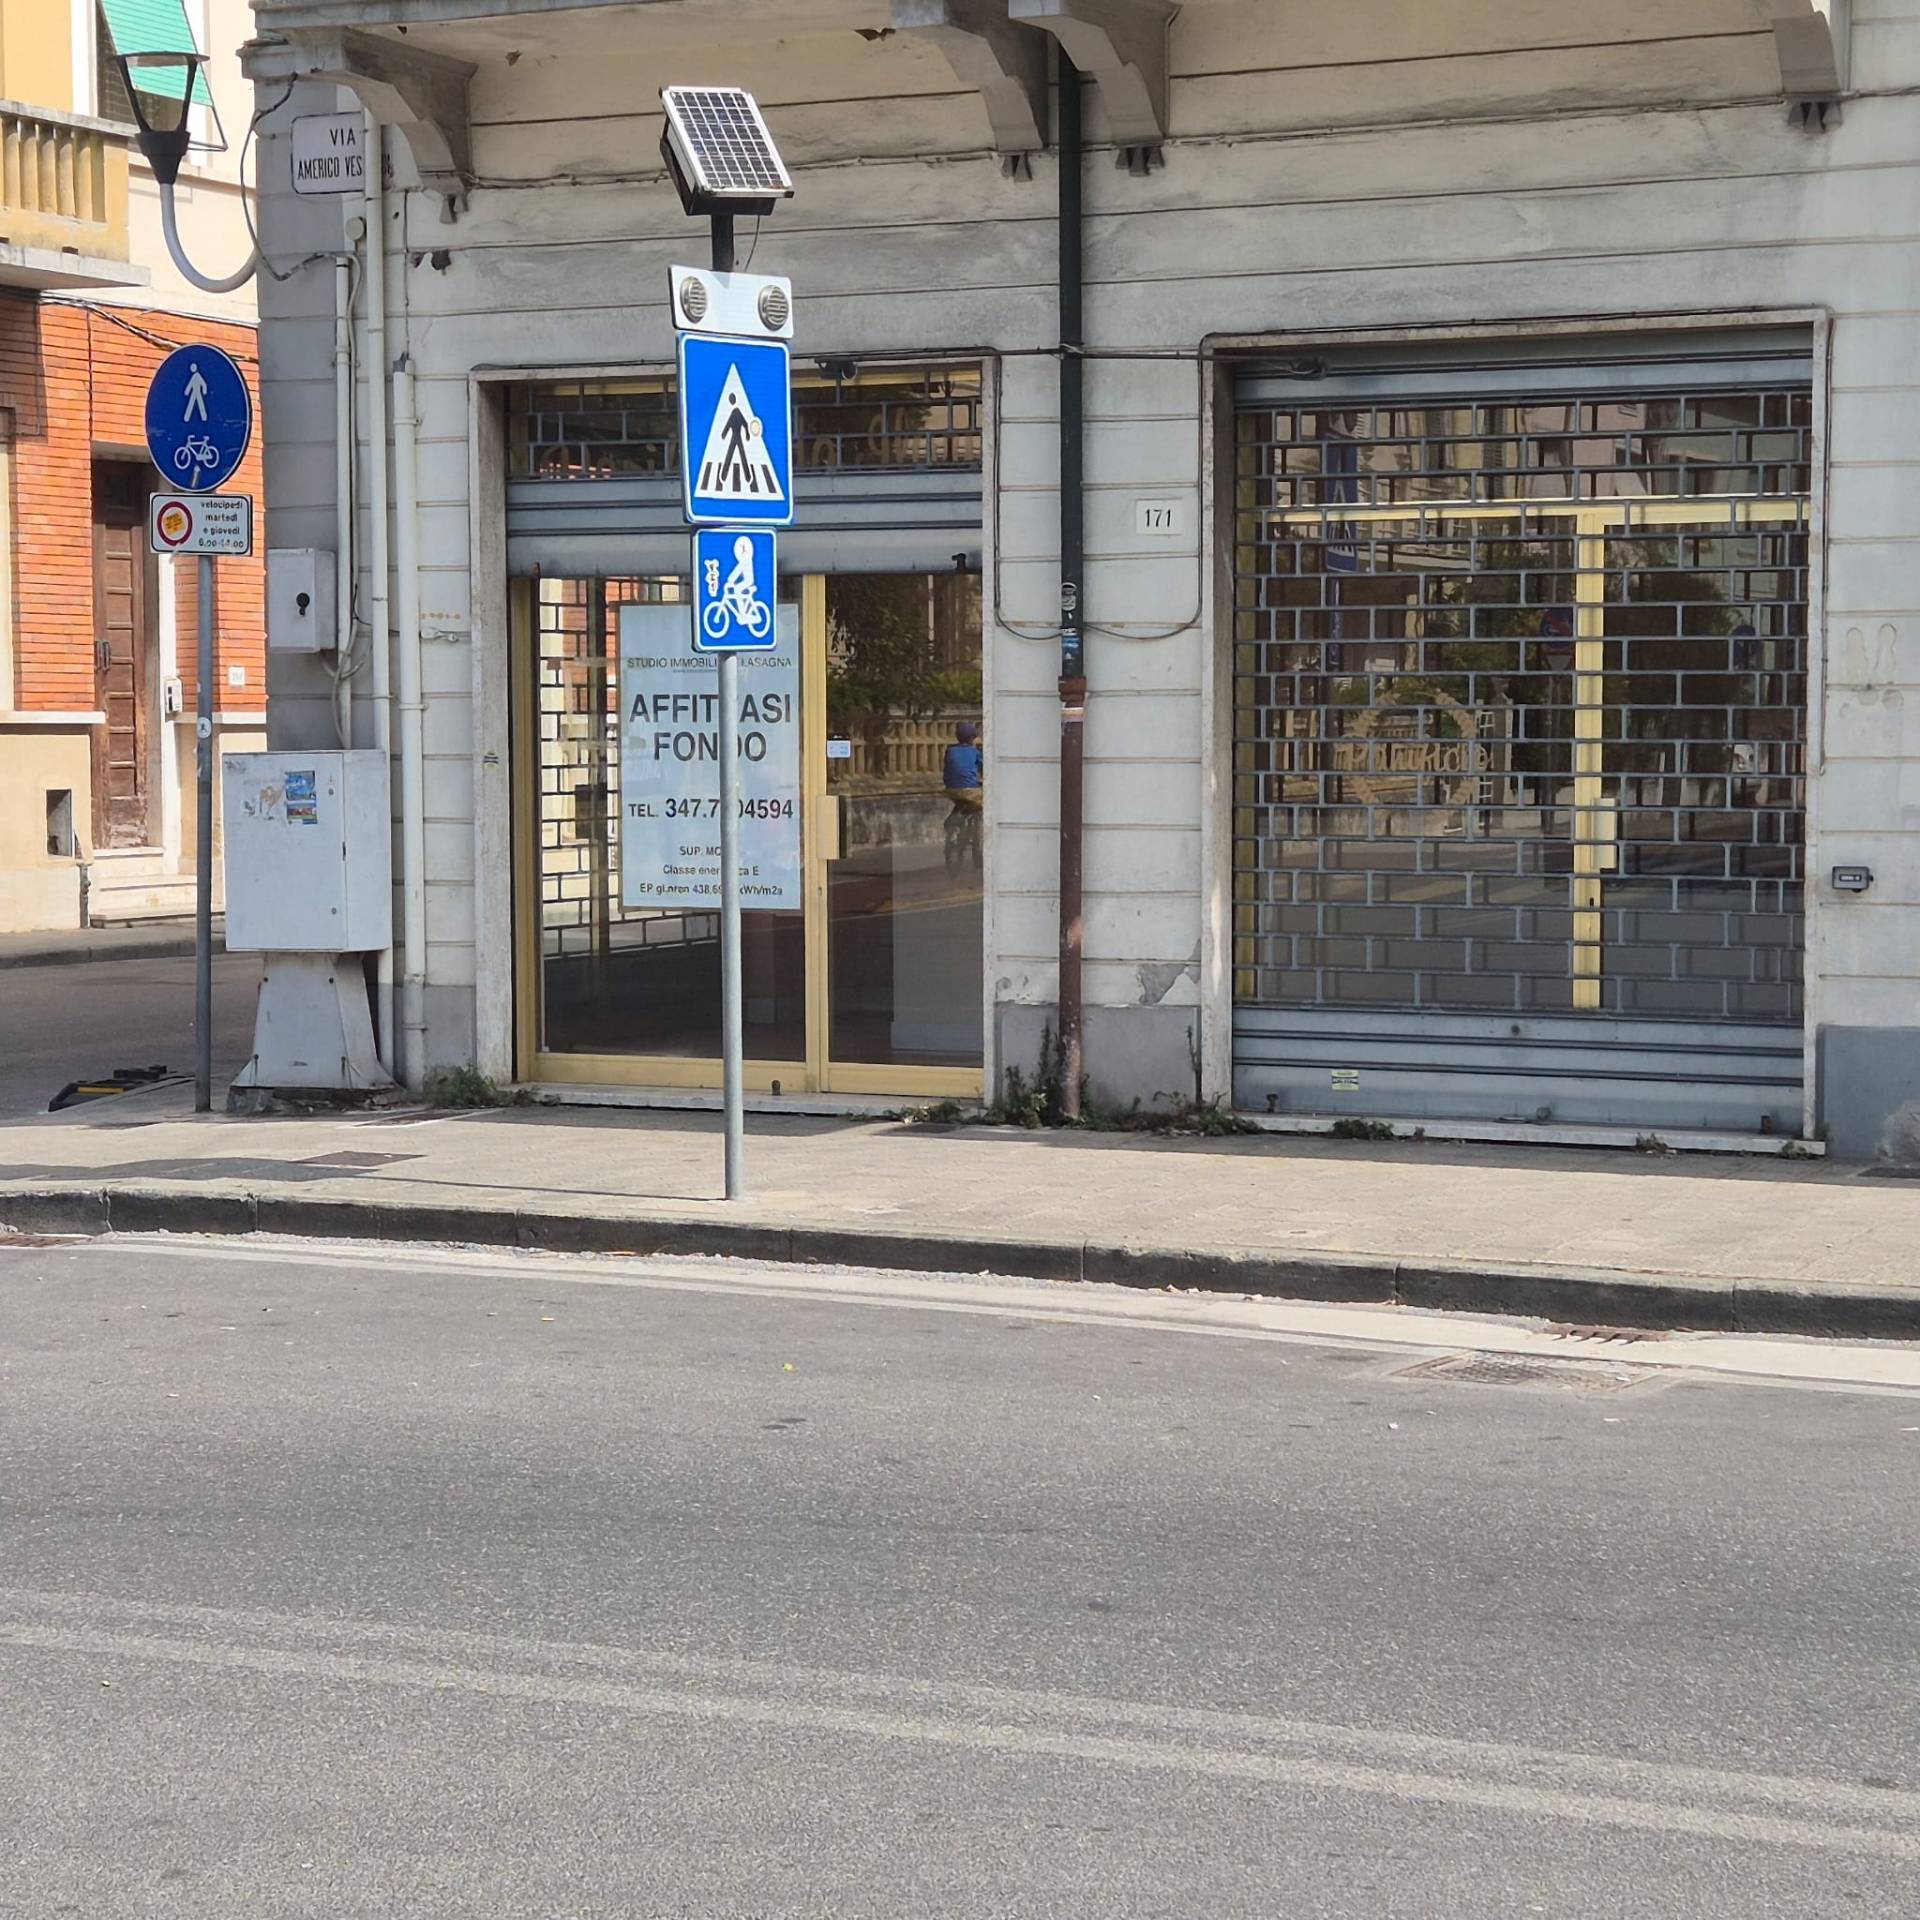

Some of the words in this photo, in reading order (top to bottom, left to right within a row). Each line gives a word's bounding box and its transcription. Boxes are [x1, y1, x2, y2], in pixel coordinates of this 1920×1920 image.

[329, 127, 356, 146] VIA
[297, 156, 340, 180] AMERICO
[1144, 508, 1171, 527] 171
[627, 657, 668, 668] STUDIO
[670, 657, 718, 668] IMMOBILI
[741, 656, 792, 668] LASAGNA
[629, 693, 791, 723] AFFITASI
[654, 731, 767, 762] FONO
[628, 803, 659, 817] TEL.
[665, 798, 794, 819] 347.74594
[663, 864, 696, 876] Classe
[752, 866, 760, 876] E
[639, 883, 653, 893] EP
